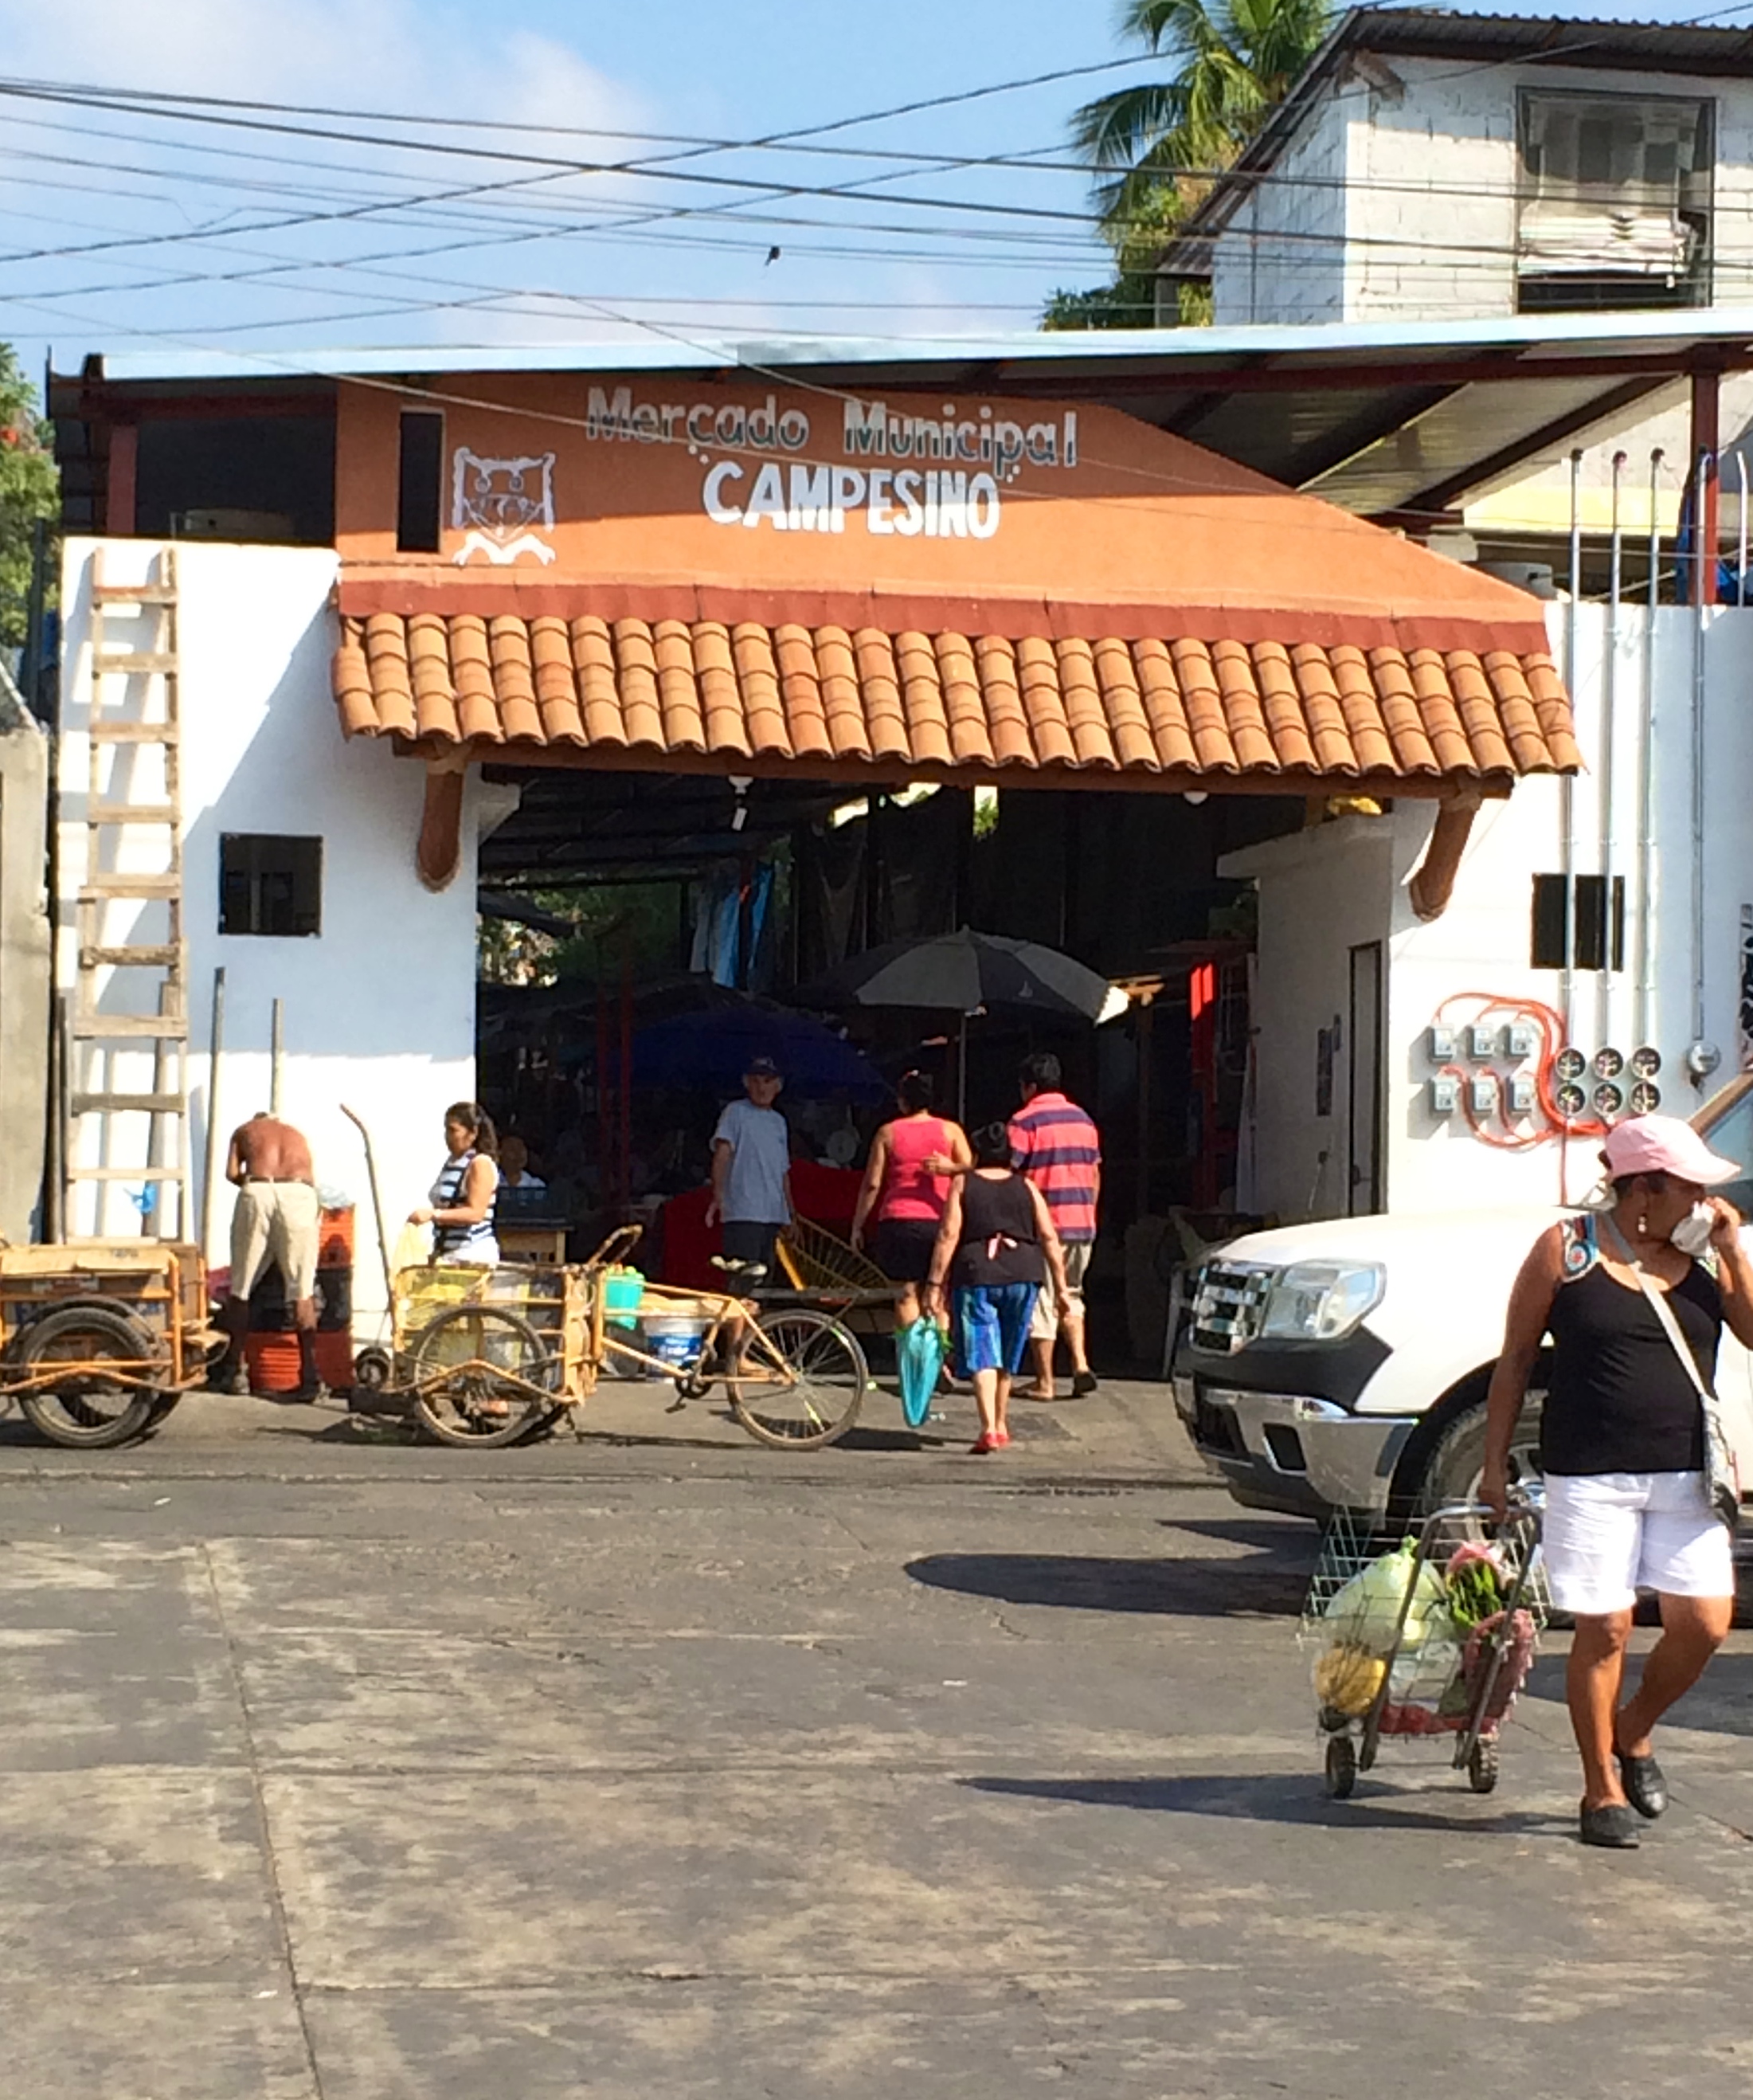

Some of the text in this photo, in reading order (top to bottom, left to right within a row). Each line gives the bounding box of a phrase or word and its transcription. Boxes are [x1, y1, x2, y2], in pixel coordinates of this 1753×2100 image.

[586, 386, 1077, 480] Mercado Municipal
[702, 460, 1000, 539] CAMPESINO
